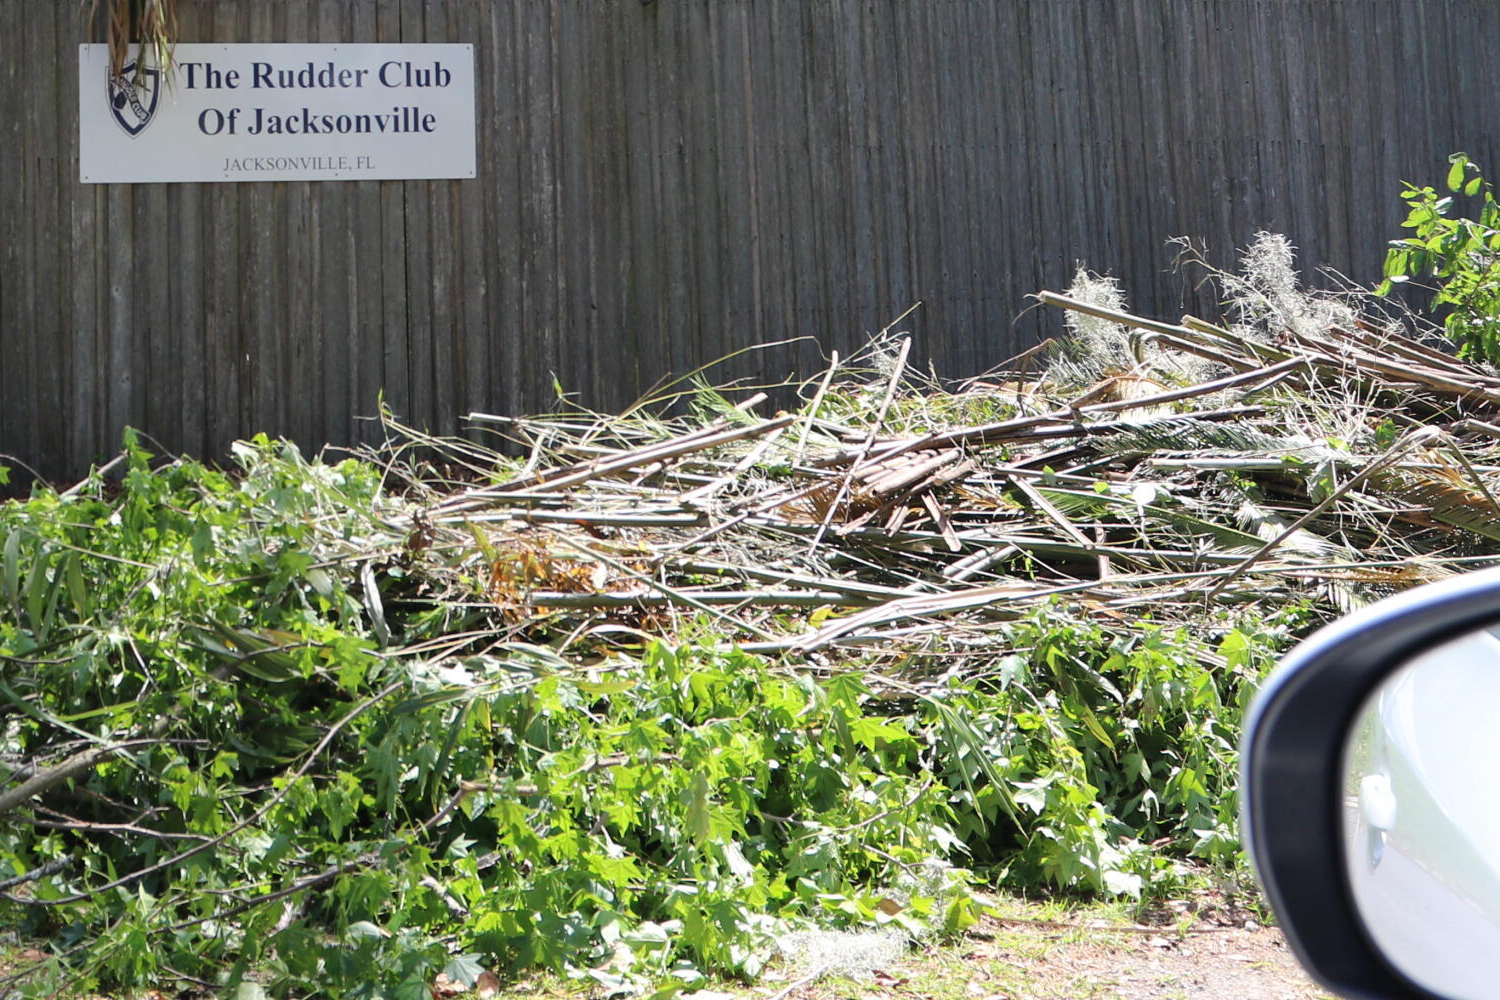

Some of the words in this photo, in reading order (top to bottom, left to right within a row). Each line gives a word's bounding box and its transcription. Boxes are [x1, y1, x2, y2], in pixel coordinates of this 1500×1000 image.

[180, 61, 240, 90] The
[252, 61, 369, 89] Rudder
[378, 60, 452, 88] Club
[197, 107, 241, 136] Of
[247, 106, 437, 136] Jacksonville
[223, 156, 353, 173] JACKSONVILLE,
[357, 156, 375, 169] FL
